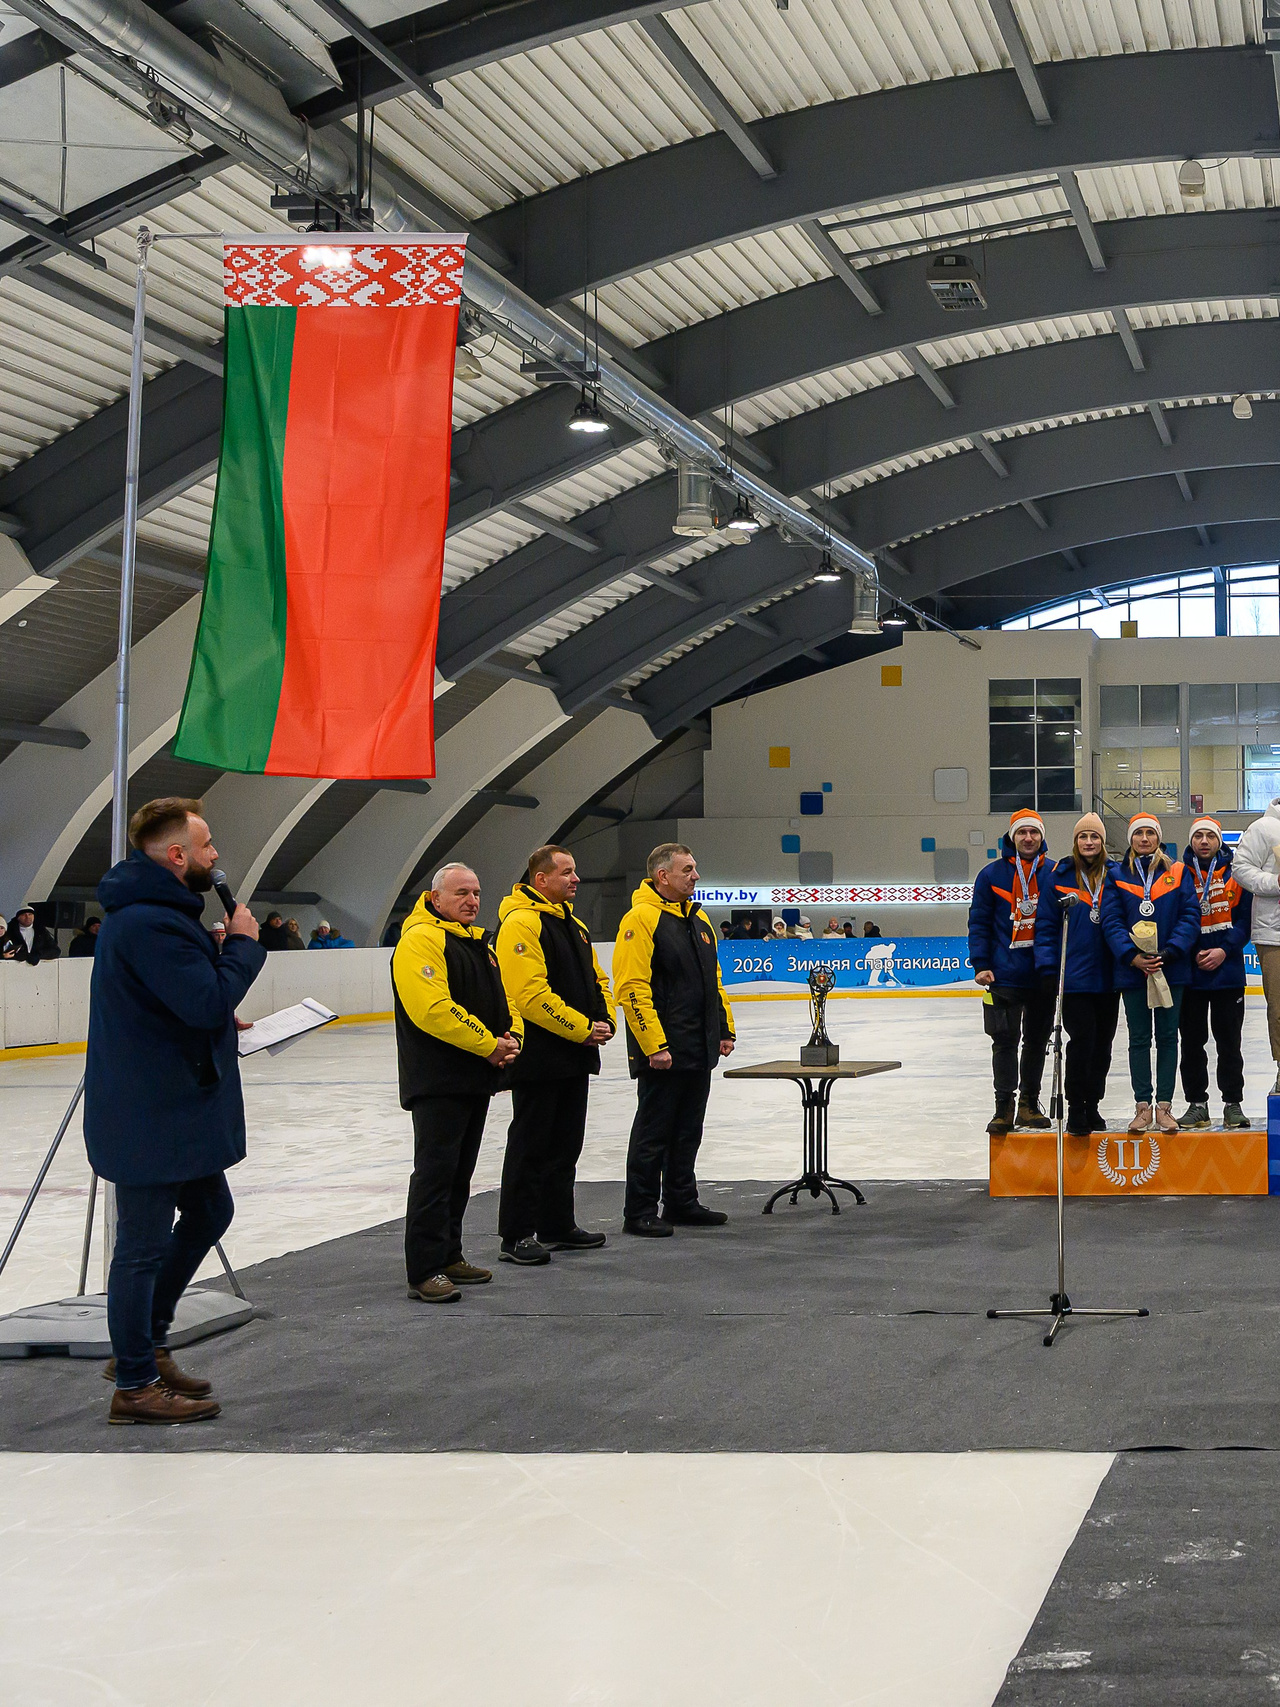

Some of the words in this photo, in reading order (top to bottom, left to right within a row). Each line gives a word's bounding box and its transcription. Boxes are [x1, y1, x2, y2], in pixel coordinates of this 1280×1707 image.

[689, 889, 758, 902] ilichy.by
[733, 957, 774, 973] 2026
[854, 957, 960, 973] спартакиада
[449, 1006, 485, 1037] BELARUS
[541, 1002, 576, 1031] BELARUS
[629, 991, 648, 1032] BELARUS
[1113, 1139, 1144, 1170] II
